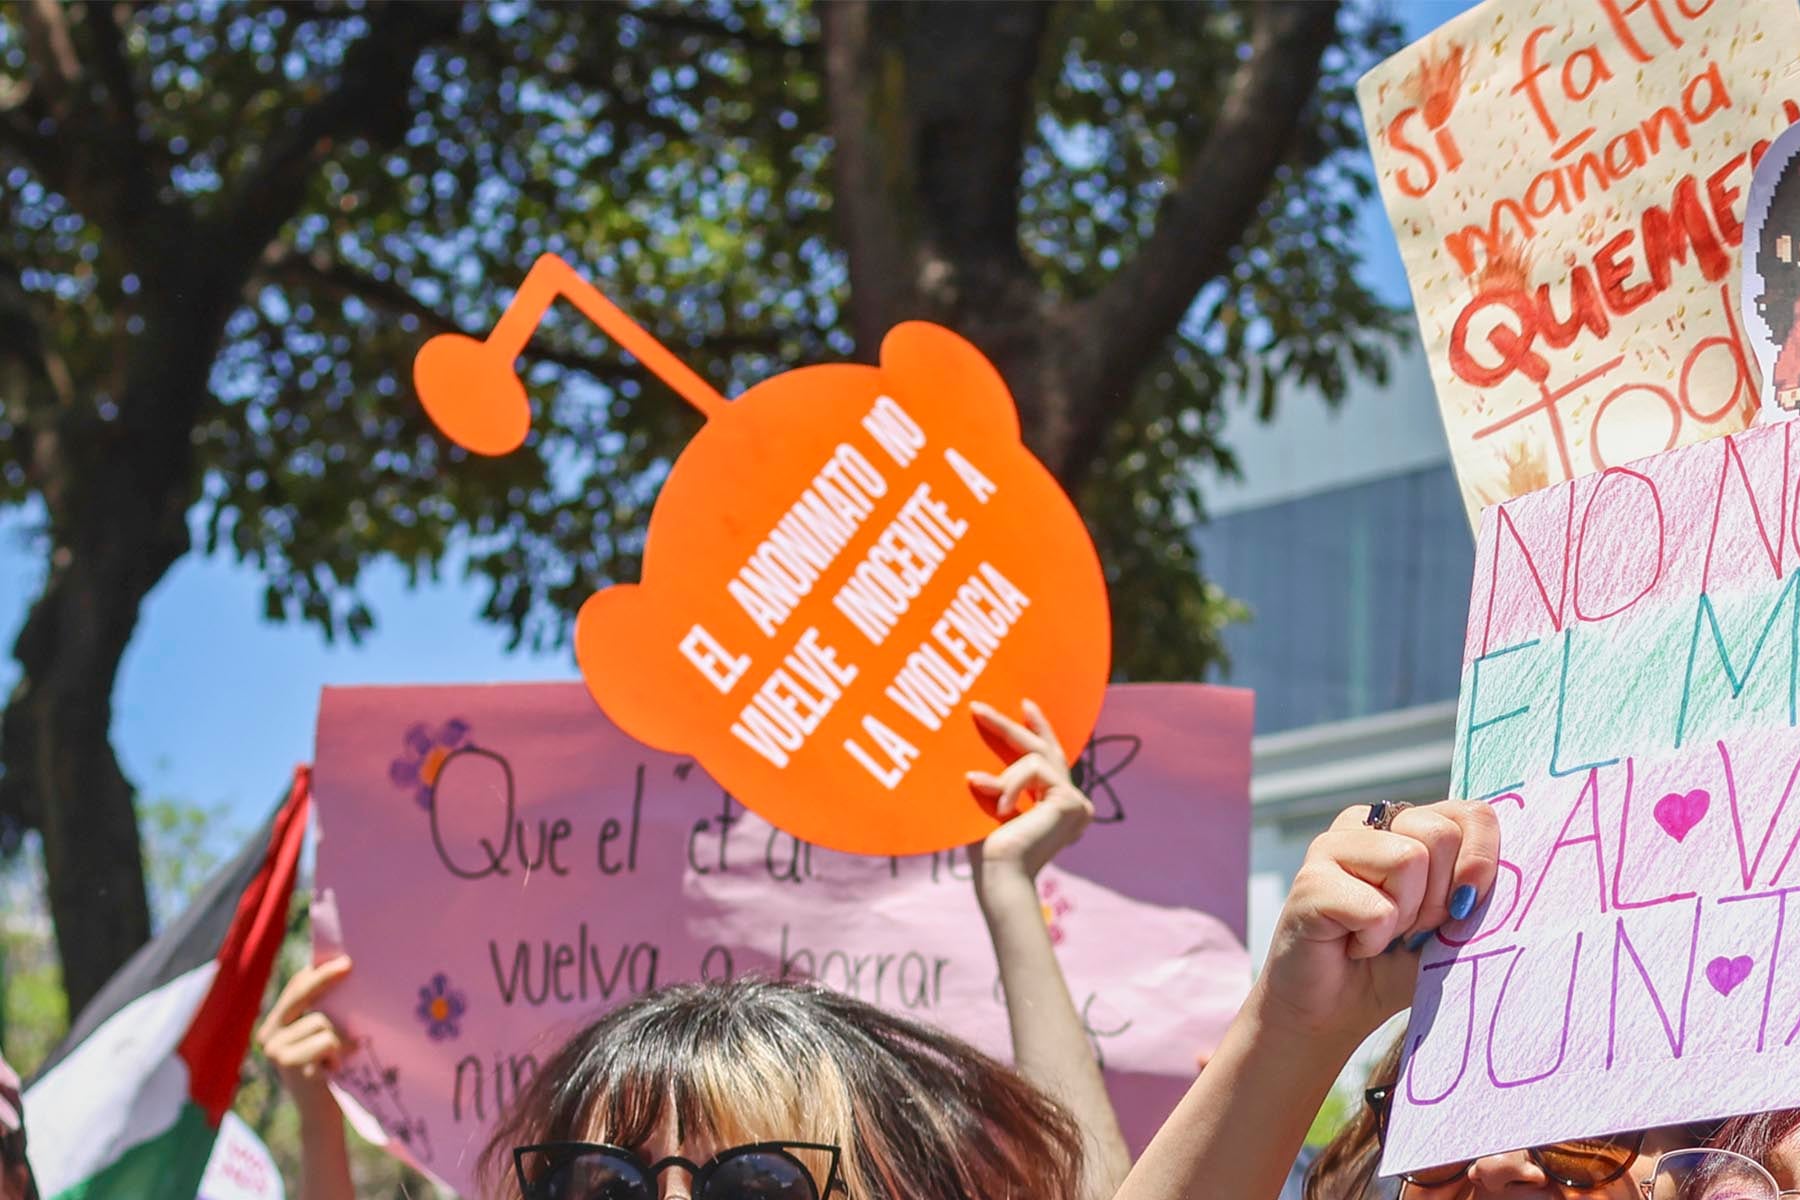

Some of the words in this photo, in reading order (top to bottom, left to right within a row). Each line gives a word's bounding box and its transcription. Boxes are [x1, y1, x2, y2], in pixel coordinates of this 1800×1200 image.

[1386, 95, 1464, 197] Si
[1444, 61, 1733, 276] mañana
[678, 624, 752, 694] EL
[727, 443, 887, 637] ANONIMATO
[862, 395, 926, 467] NO
[730, 627, 858, 769] VUELVE
[832, 483, 968, 645] INOCENTE
[944, 447, 997, 504] A
[1482, 466, 1665, 660] NO
[844, 715, 920, 790] LA
[885, 562, 1031, 731] VIOLENCIA
[1463, 627, 1620, 799] EL
[430, 744, 573, 880] Que
[598, 764, 646, 876] el
[488, 922, 660, 1006] vuelva
